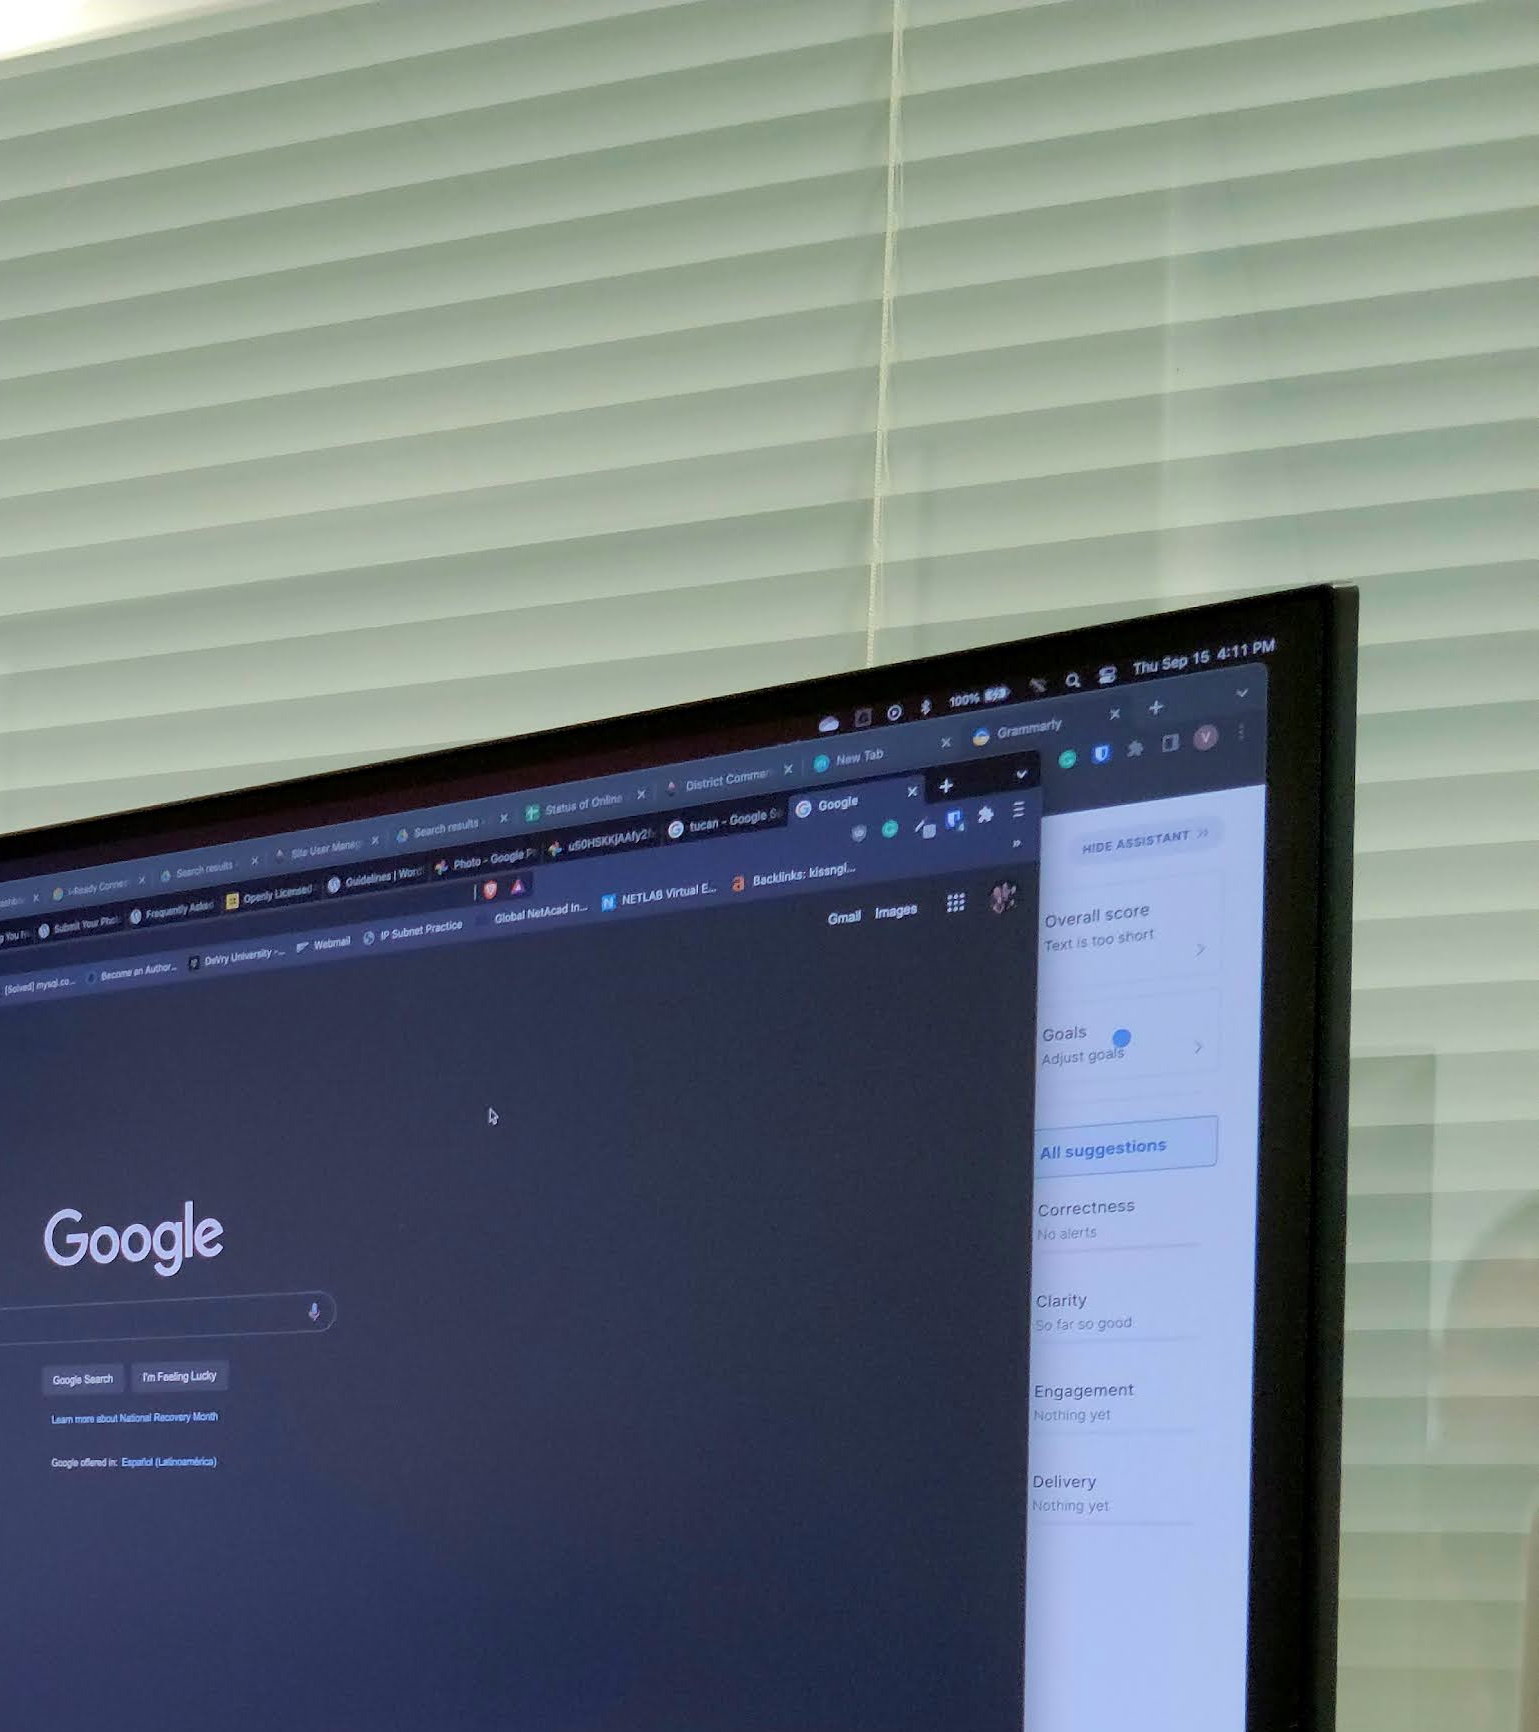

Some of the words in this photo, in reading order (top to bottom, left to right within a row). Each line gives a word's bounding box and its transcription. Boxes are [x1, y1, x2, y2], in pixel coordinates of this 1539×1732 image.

[1133, 657, 1158, 675] Thu
[1162, 654, 1188, 672] Sep
[1193, 650, 1209, 666] 15
[1217, 644, 1246, 663] 4:11
[1250, 638, 1276, 655] PM
[949, 691, 980, 707] 100%
[997, 718, 1062, 742] Grammarly
[836, 752, 860, 766] New
[864, 748, 884, 761] Tab
[685, 775, 723, 792] District
[545, 804, 577, 817] Status
[579, 800, 590, 811] of
[818, 796, 859, 812] Google
[448, 818, 479, 831] results
[689, 818, 719, 833] tucan
[730, 810, 768, 826] Google
[1082, 841, 1113, 855] HIDE
[1115, 830, 1190, 850] ASSISTANT
[453, 855, 482, 870] Photo
[490, 851, 525, 865] Google
[345, 871, 392, 889] Guidelines
[753, 871, 807, 887] Backlinks:
[243, 891, 274, 905] Openly
[274, 884, 313, 900] Licensed
[622, 892, 663, 905] NETLAB
[666, 884, 699, 899] Virtual
[495, 910, 525, 925] Global
[527, 903, 569, 920] NetAcad
[828, 908, 861, 926] Gmail
[875, 902, 917, 921] Images
[1045, 909, 1101, 930] Overall
[1105, 904, 1150, 922] score
[380, 931, 389, 941] IP
[392, 926, 423, 940] Subnet
[425, 919, 463, 935] Practice
[314, 936, 351, 950] Webmail
[1045, 938, 1073, 953] Text
[1077, 938, 1088, 949] is
[1092, 934, 1114, 948] too
[1118, 929, 1154, 944] short
[204, 953, 229, 967] DeVry
[231, 950, 272, 963] University
[1042, 1026, 1087, 1042] Goals
[1041, 1051, 1084, 1067] Adjust
[1088, 1048, 1125, 1064] goals
[1040, 1146, 1061, 1161] All
[1065, 1139, 1167, 1162] suggestions
[1038, 1200, 1135, 1218] Correctness
[44, 1200, 224, 1277] Google
[1037, 1228, 1056, 1241] No
[1059, 1226, 1097, 1240] alerts
[1036, 1294, 1087, 1311] Clarity
[1035, 1319, 1053, 1331] So
[1056, 1318, 1074, 1330] far
[1078, 1319, 1095, 1330] so
[1098, 1316, 1132, 1332] good
[52, 1375, 82, 1387] Google
[84, 1373, 114, 1384] Search
[142, 1372, 156, 1382] I'm
[157, 1371, 189, 1384] Feeling
[190, 1370, 217, 1383] Lucky
[1034, 1383, 1134, 1401] Engagement
[51, 1415, 73, 1424] Learn
[74, 1416, 95, 1424] more
[96, 1414, 118, 1423] about
[119, 1413, 151, 1423] National
[153, 1412, 192, 1424] Recovery
[192, 1411, 218, 1422] Month
[1033, 1408, 1086, 1424] Nothing
[1090, 1408, 1110, 1423] yet
[51, 1458, 79, 1469] Google
[80, 1457, 107, 1467] offered
[108, 1457, 118, 1467] in:
[1033, 1474, 1097, 1492] Delivery
[1033, 1499, 1084, 1514] Nothing
[1088, 1499, 1109, 1514] yet
